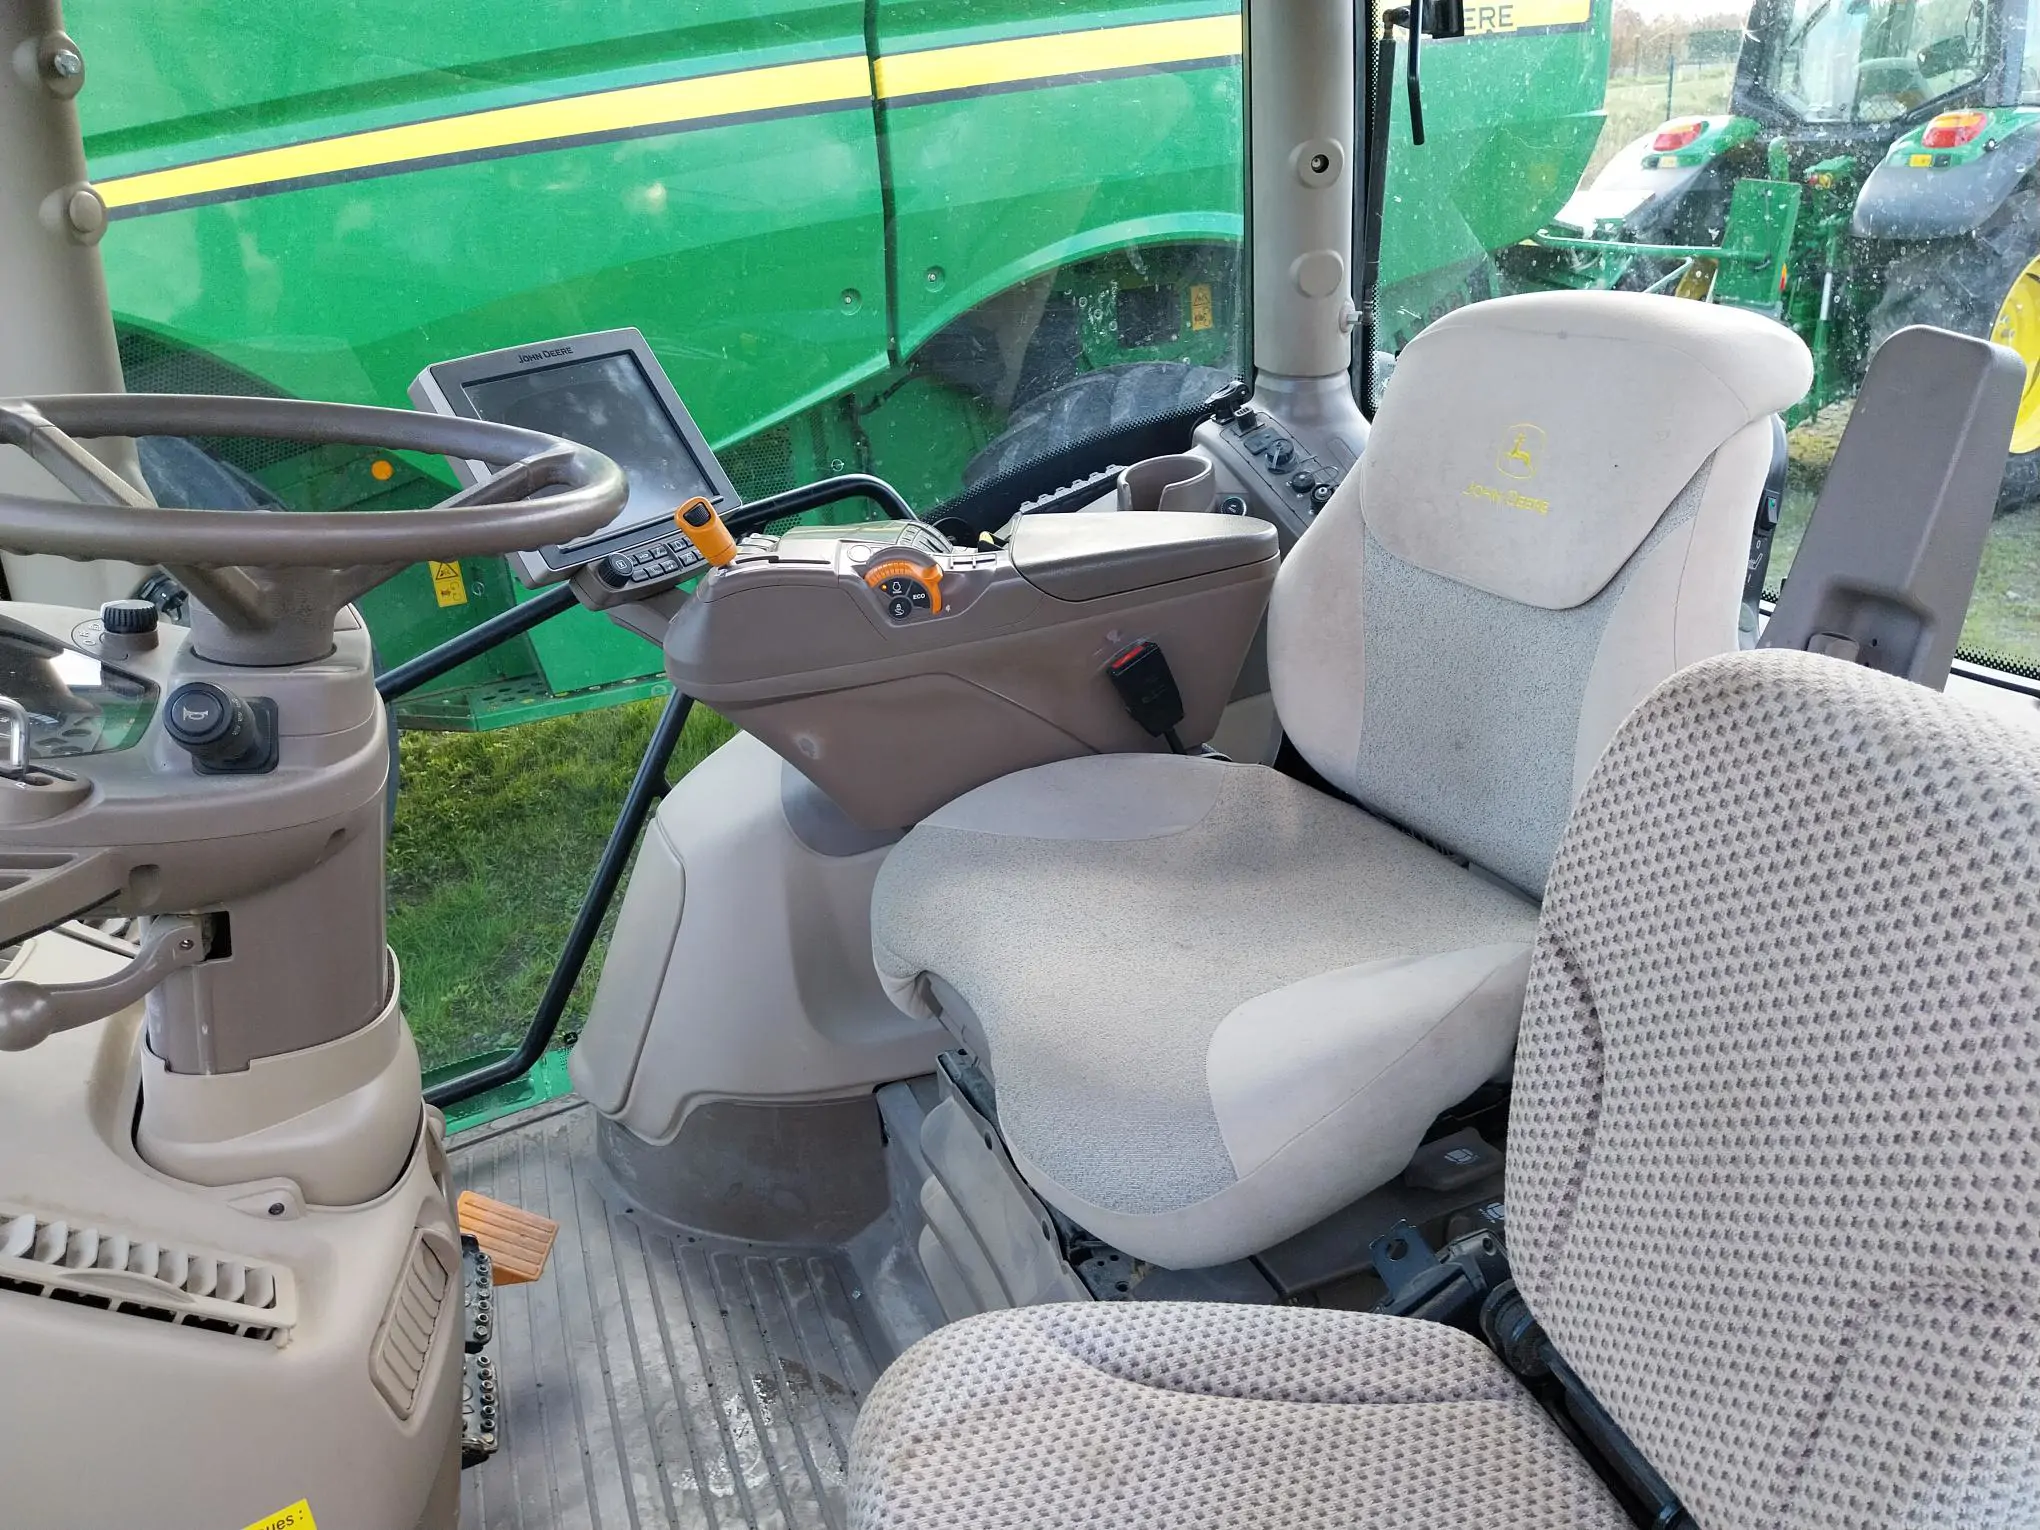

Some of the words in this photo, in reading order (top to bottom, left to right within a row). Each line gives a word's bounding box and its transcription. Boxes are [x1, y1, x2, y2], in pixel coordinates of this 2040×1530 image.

[1464, 5, 1513, 30] ERE
[518, 353, 543, 364] JOHN
[542, 346, 574, 358] DEERE
[912, 592, 926, 600] ECO
